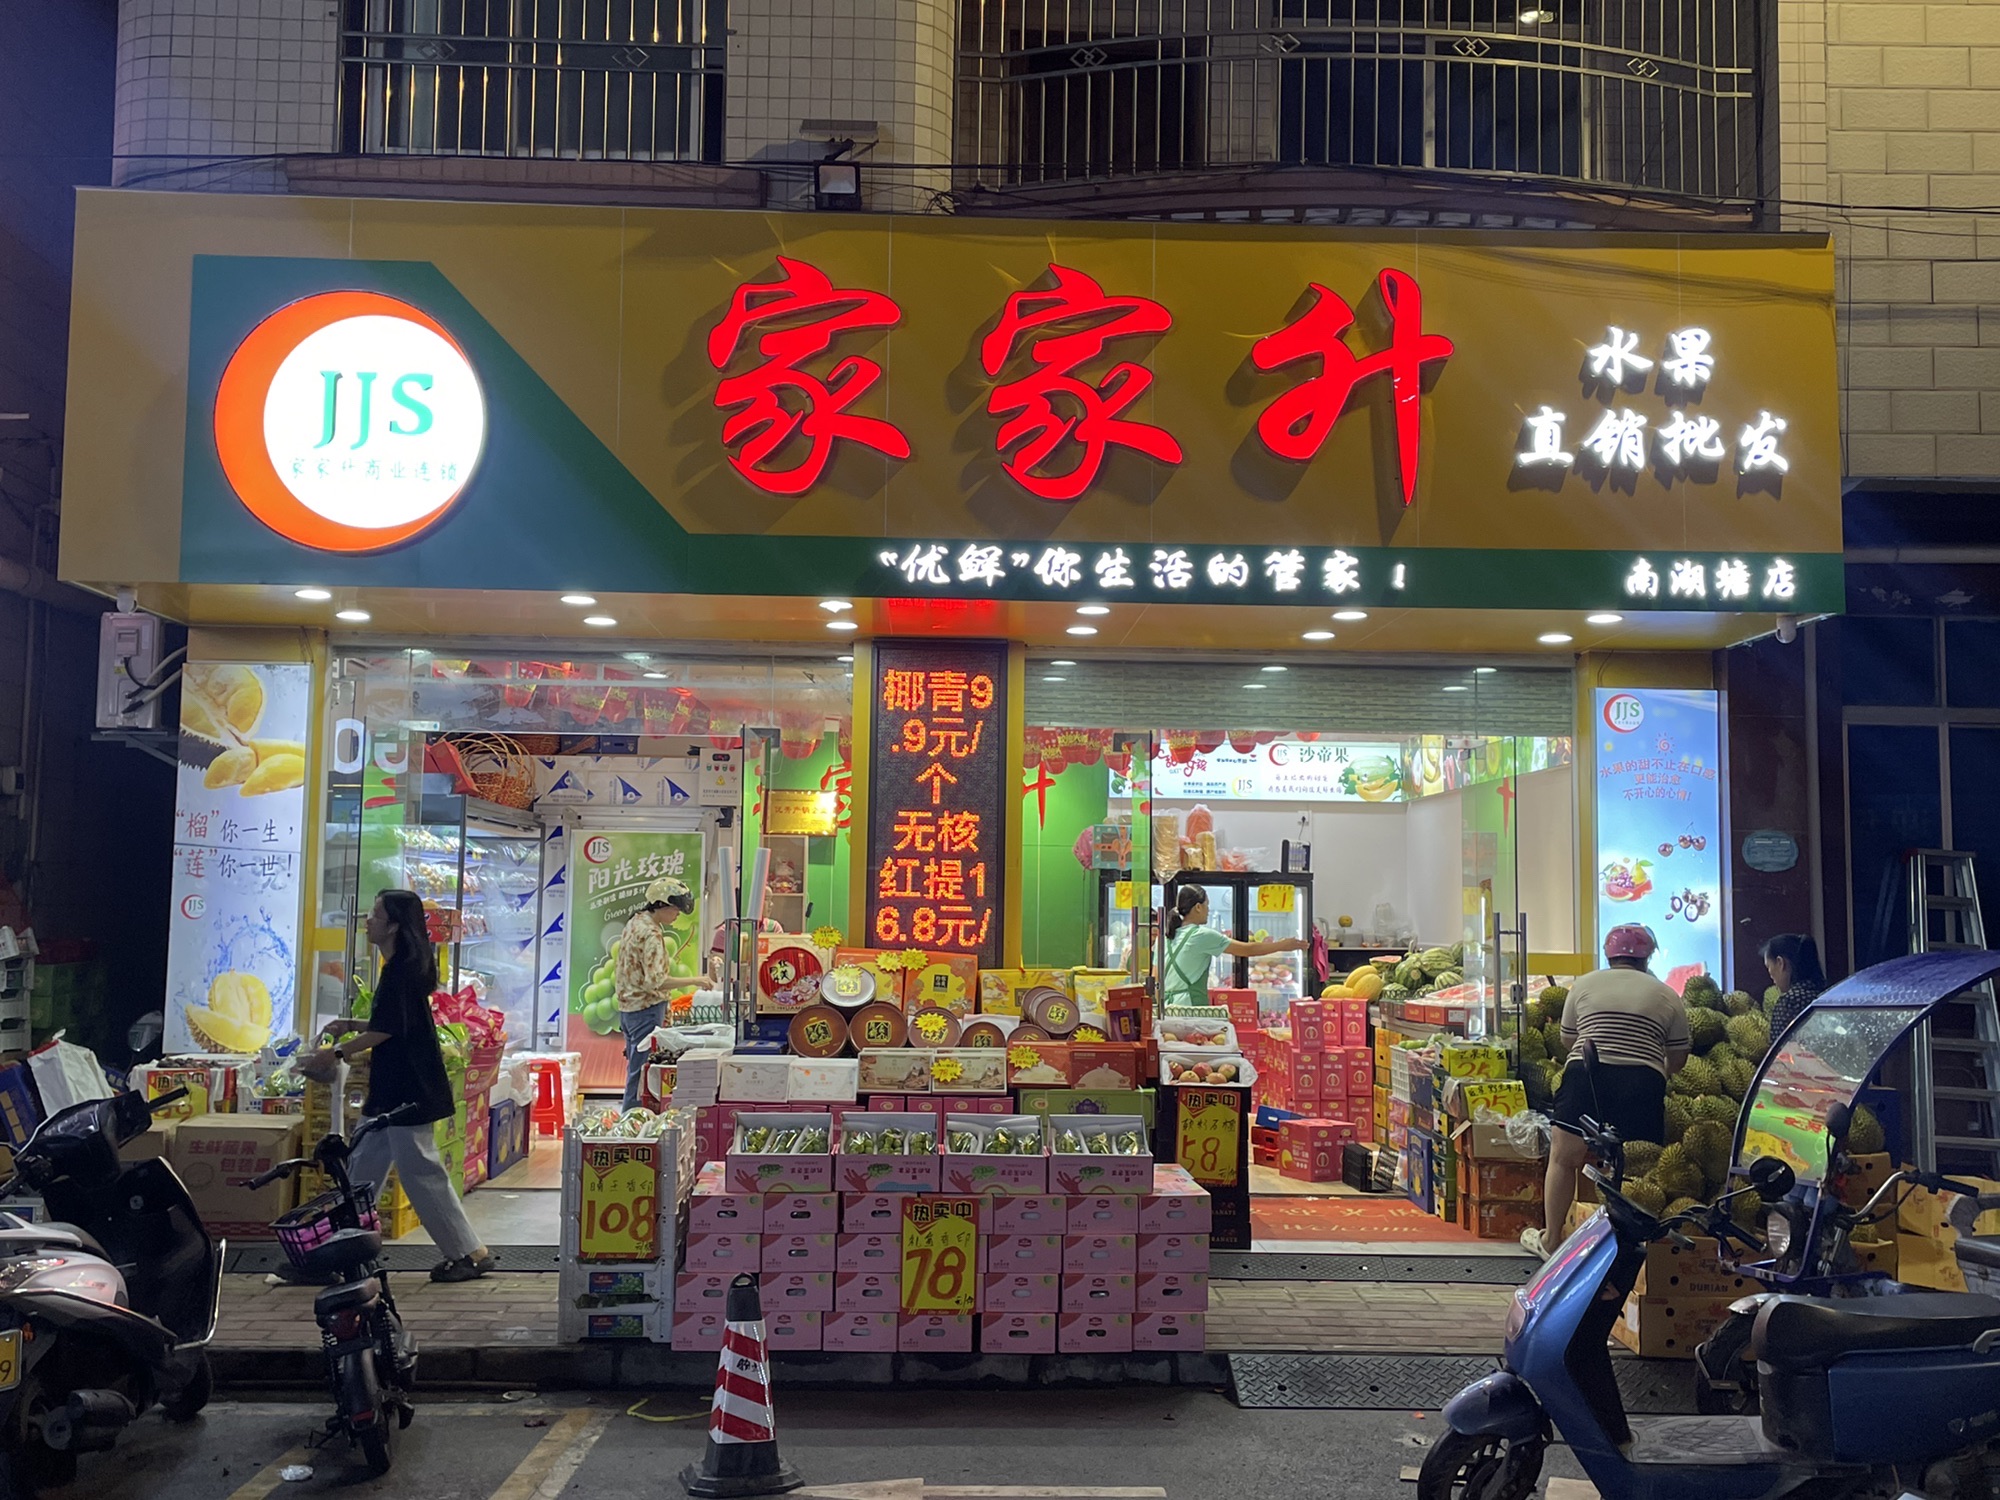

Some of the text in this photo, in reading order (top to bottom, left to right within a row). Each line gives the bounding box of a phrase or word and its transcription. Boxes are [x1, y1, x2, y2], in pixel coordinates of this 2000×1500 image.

[1587, 325, 1715, 386] 水果
[707, 255, 1454, 506] 家家升
[313, 369, 435, 450] JJS
[1518, 405, 1789, 472] 直销批发
[884, 669, 994, 712] 椰青9
[1615, 700, 1640, 721] JJS
[892, 716, 984, 758] .9元/
[916, 761, 959, 805] 个
[1238, 779, 1253, 791] JJS
[592, 841, 609, 855] JJS
[894, 810, 981, 853] 无核
[588, 848, 684, 894] 阳光玫瑰
[879, 856, 986, 900] 红提1
[188, 899, 204, 912] JJS
[603, 908, 627, 922] Green
[875, 904, 994, 948] 6.8元/
[1188, 1092, 1236, 1107] 热卖中
[592, 1147, 652, 1167] 热卖中
[1182, 1135, 1220, 1173] 58
[585, 1195, 656, 1243] 108
[912, 1203, 972, 1221] 热卖中
[906, 1245, 967, 1308] 78
[1689, 1282, 1729, 1293] DURIAN
[0, 1360, 12, 1382] 9
